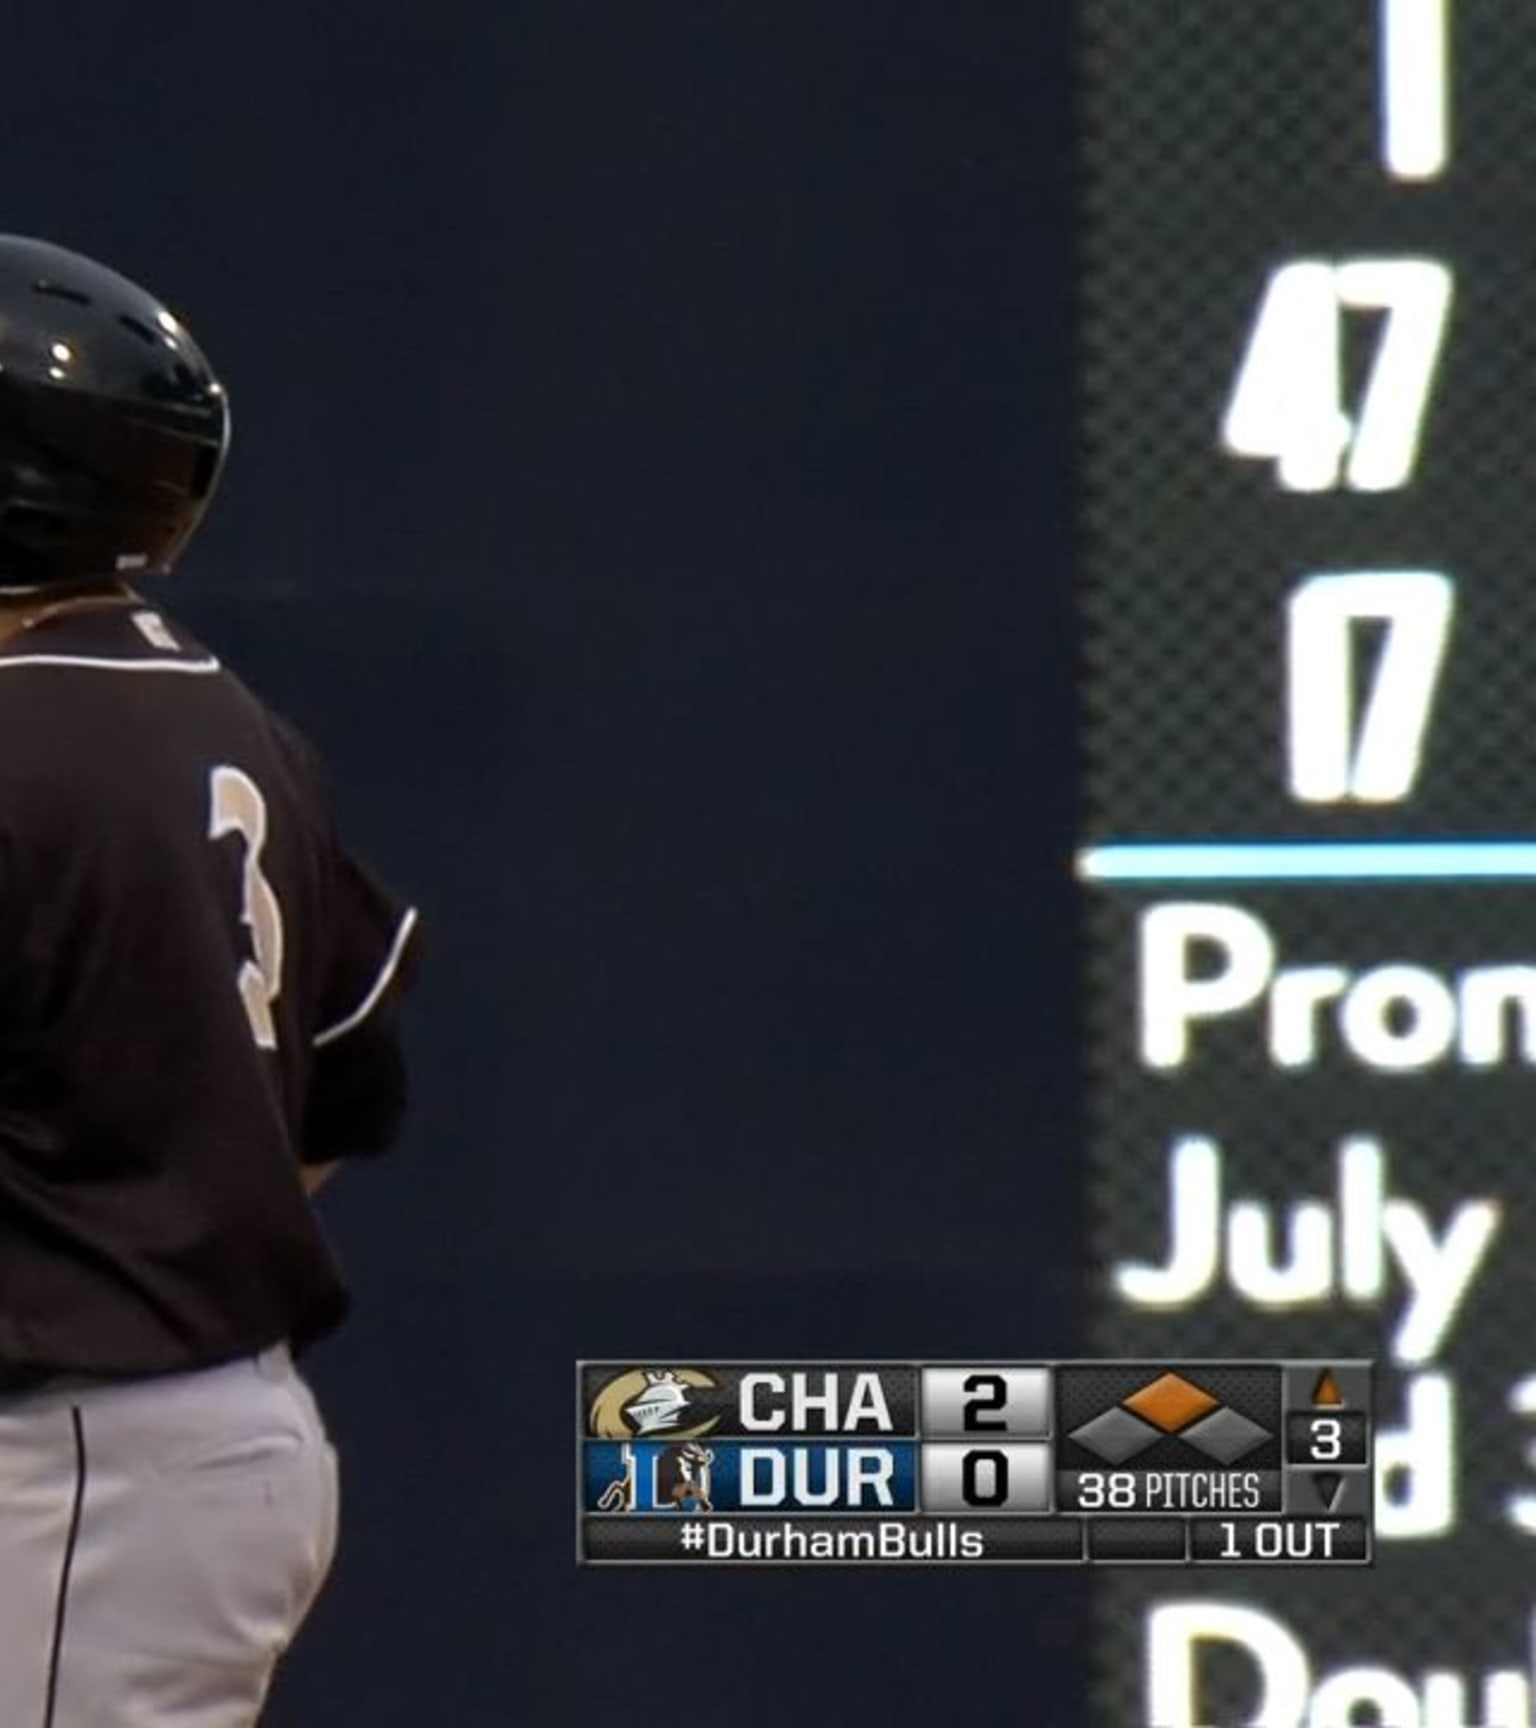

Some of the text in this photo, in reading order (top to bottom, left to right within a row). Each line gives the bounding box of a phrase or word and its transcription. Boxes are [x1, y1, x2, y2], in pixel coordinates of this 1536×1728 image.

[1222, 257, 1453, 493] 47
[1286, 570, 1454, 804] 17
[209, 765, 285, 1050] 3
[1114, 1136, 1500, 1364] July
[1146, 1600, 1536, 1728] Dou
